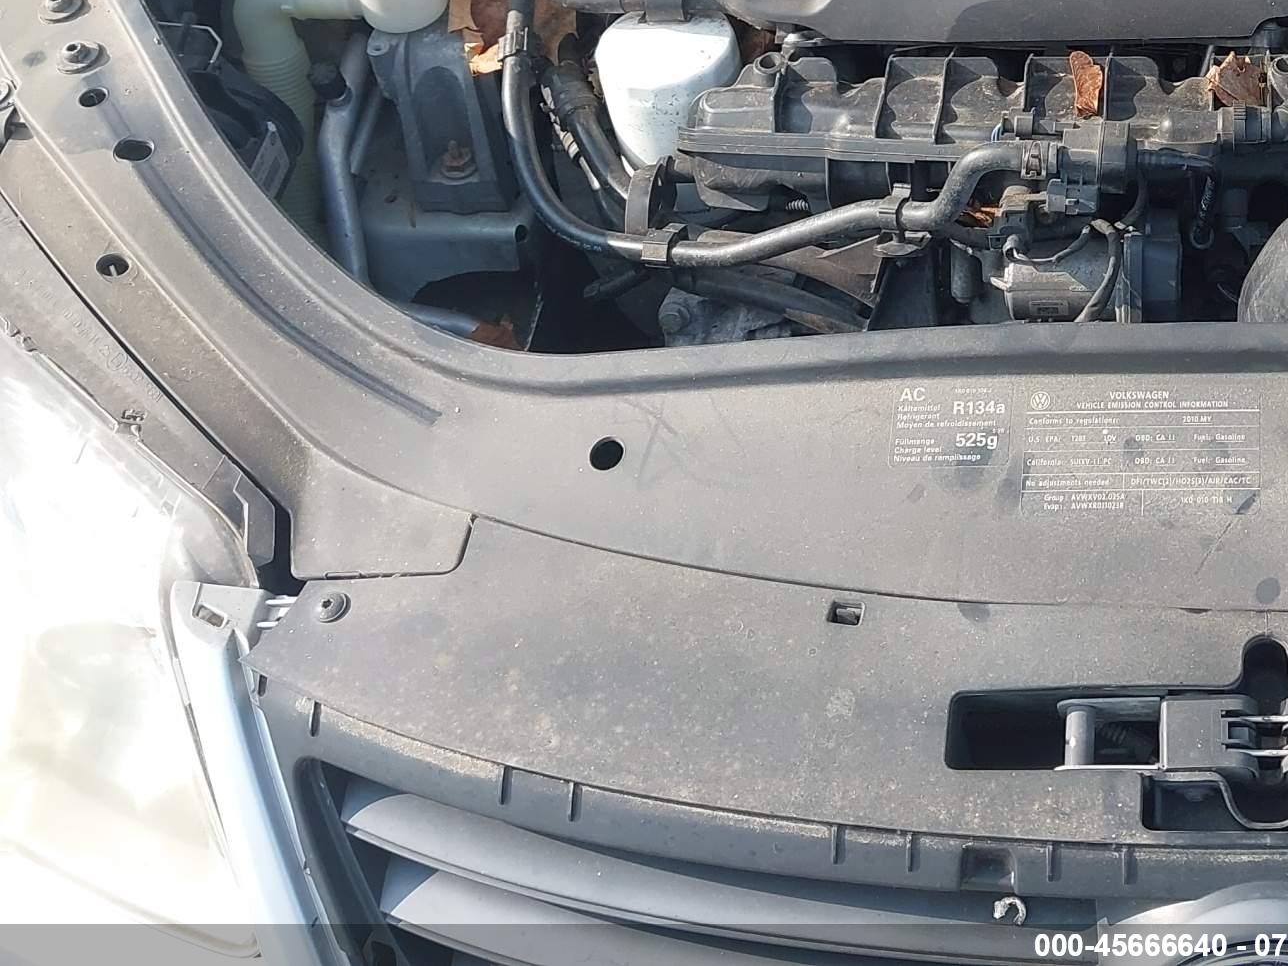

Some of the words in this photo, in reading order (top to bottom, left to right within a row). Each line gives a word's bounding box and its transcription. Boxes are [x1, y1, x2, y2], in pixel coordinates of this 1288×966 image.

[900, 387, 926, 401] AC
[1109, 391, 1169, 400] VOLKSWAGEN
[953, 400, 1006, 415] R134a
[1076, 401, 1105, 409] VEHICLE
[1107, 401, 1141, 409] EMISSION
[1179, 400, 1228, 408] INFORMATION
[1029, 417, 1063, 425] Conforms
[955, 432, 998, 449] 525g
[1215, 433, 1246, 441] Gasoline
[894, 446, 921, 454] Charge
